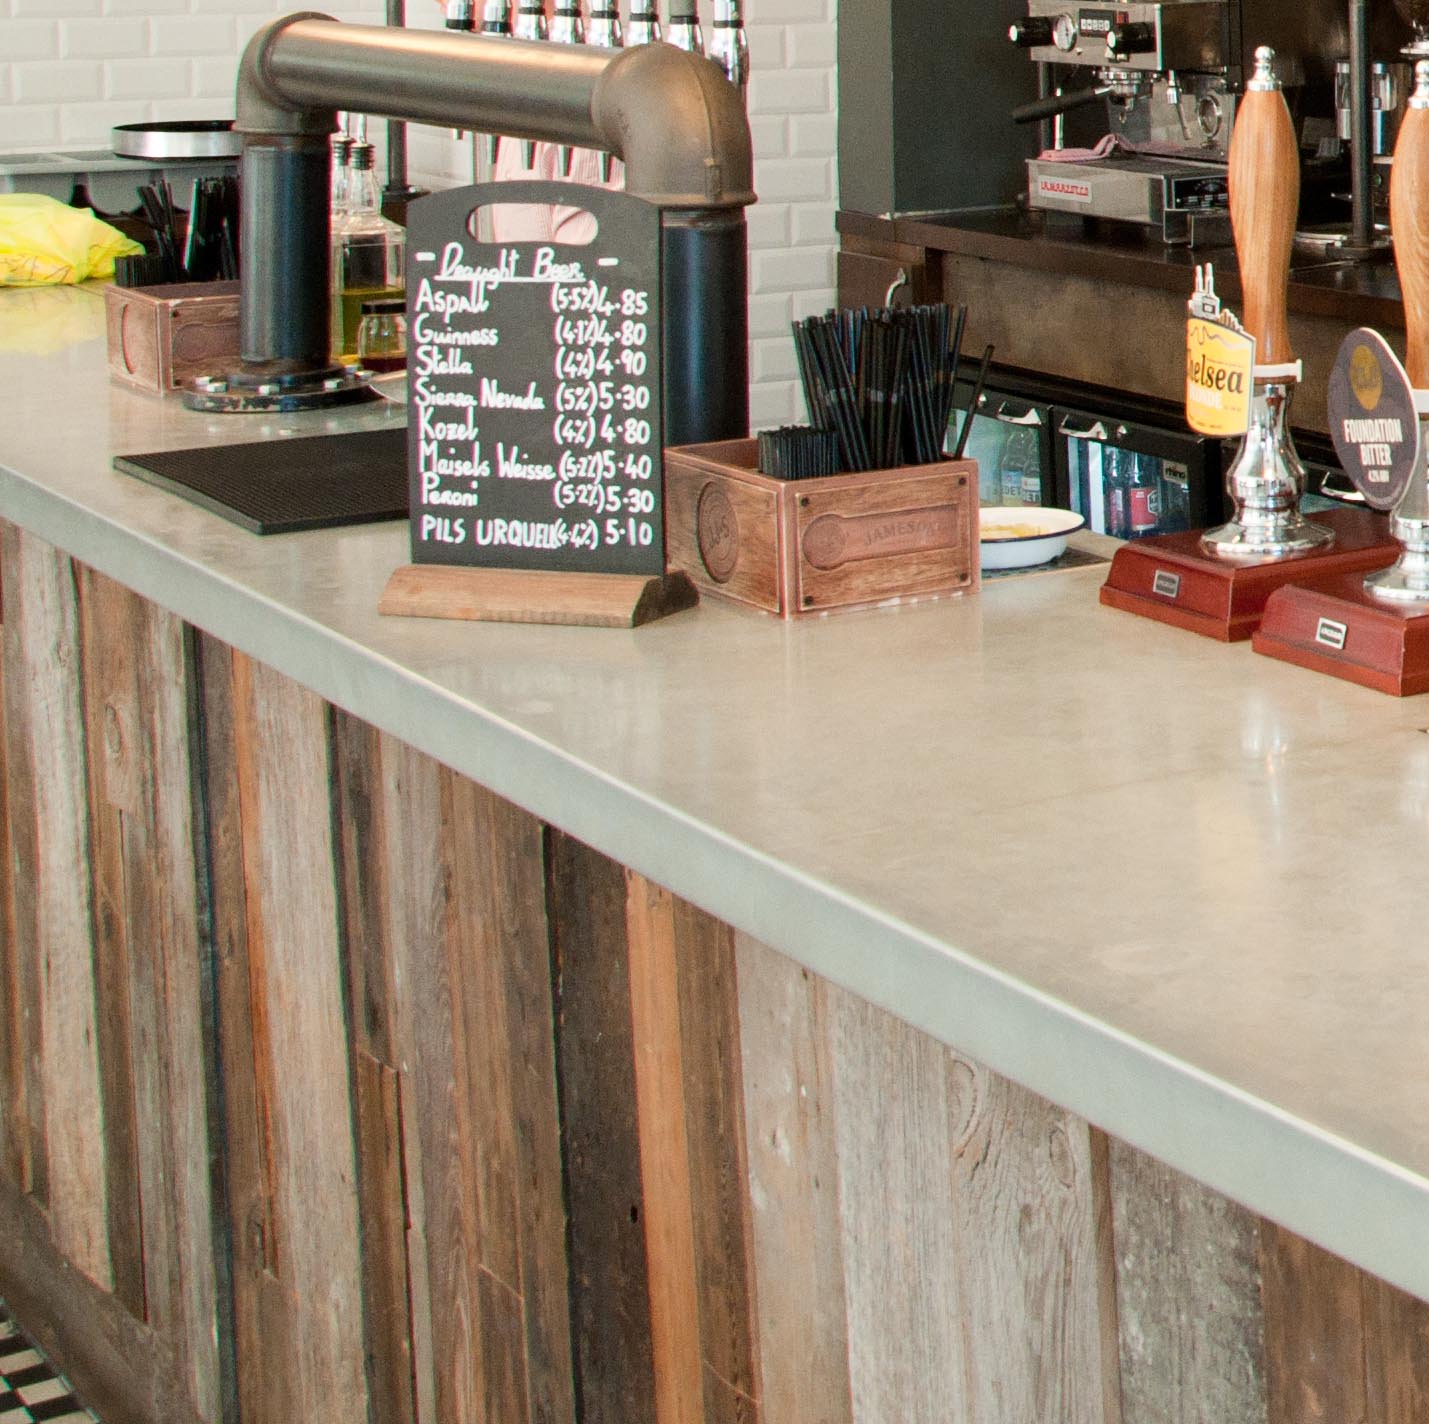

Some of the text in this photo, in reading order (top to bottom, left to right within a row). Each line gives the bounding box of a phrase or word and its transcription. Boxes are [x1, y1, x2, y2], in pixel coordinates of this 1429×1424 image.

[415, 280, 489, 322] Aspall
[414, 313, 498, 346] Guinness
[414, 345, 473, 376] Stella
[480, 379, 545, 411] Nevada
[417, 407, 479, 441] Kozel
[1343, 418, 1403, 443] FOUNDATION
[499, 444, 556, 480] Weisse
[1360, 443, 1392, 466] BITTER
[420, 472, 478, 507] Peroni
[420, 514, 465, 544] PILS
